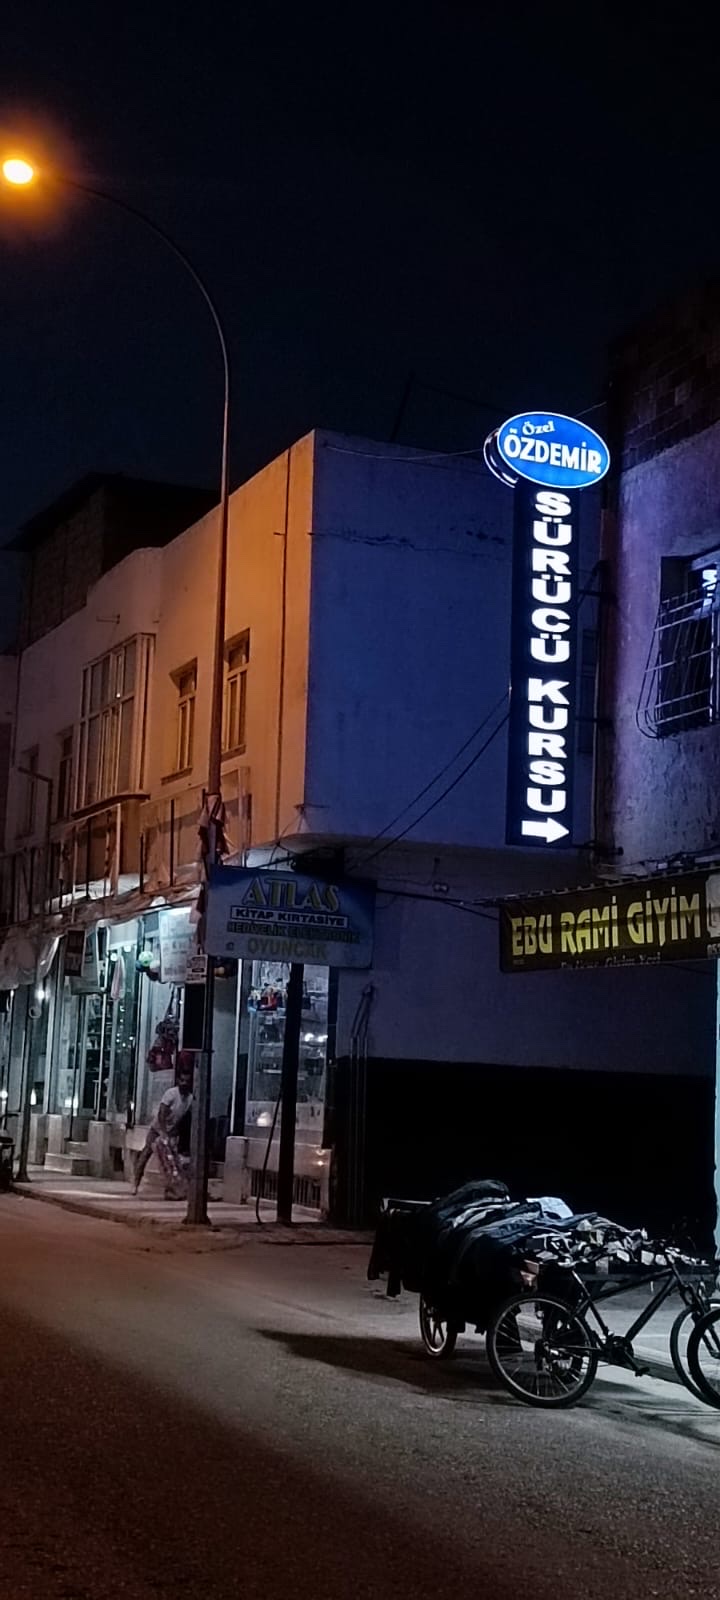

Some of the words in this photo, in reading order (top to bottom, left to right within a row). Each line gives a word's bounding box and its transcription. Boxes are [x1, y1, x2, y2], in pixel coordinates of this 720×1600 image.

[522, 420, 555, 436] Özel
[503, 429, 602, 474] ÖZDEMİR
[530, 491, 572, 663] SÜRÜCÜ
[526, 677, 570, 813] KURSU
[236, 908, 274, 920] KİTAP
[242, 874, 341, 913] ATLAS
[511, 914, 553, 956] EBU
[560, 895, 620, 956] RAMİ
[626, 886, 702, 947] GİYİM
[247, 938, 329, 960] OYUNCAK
